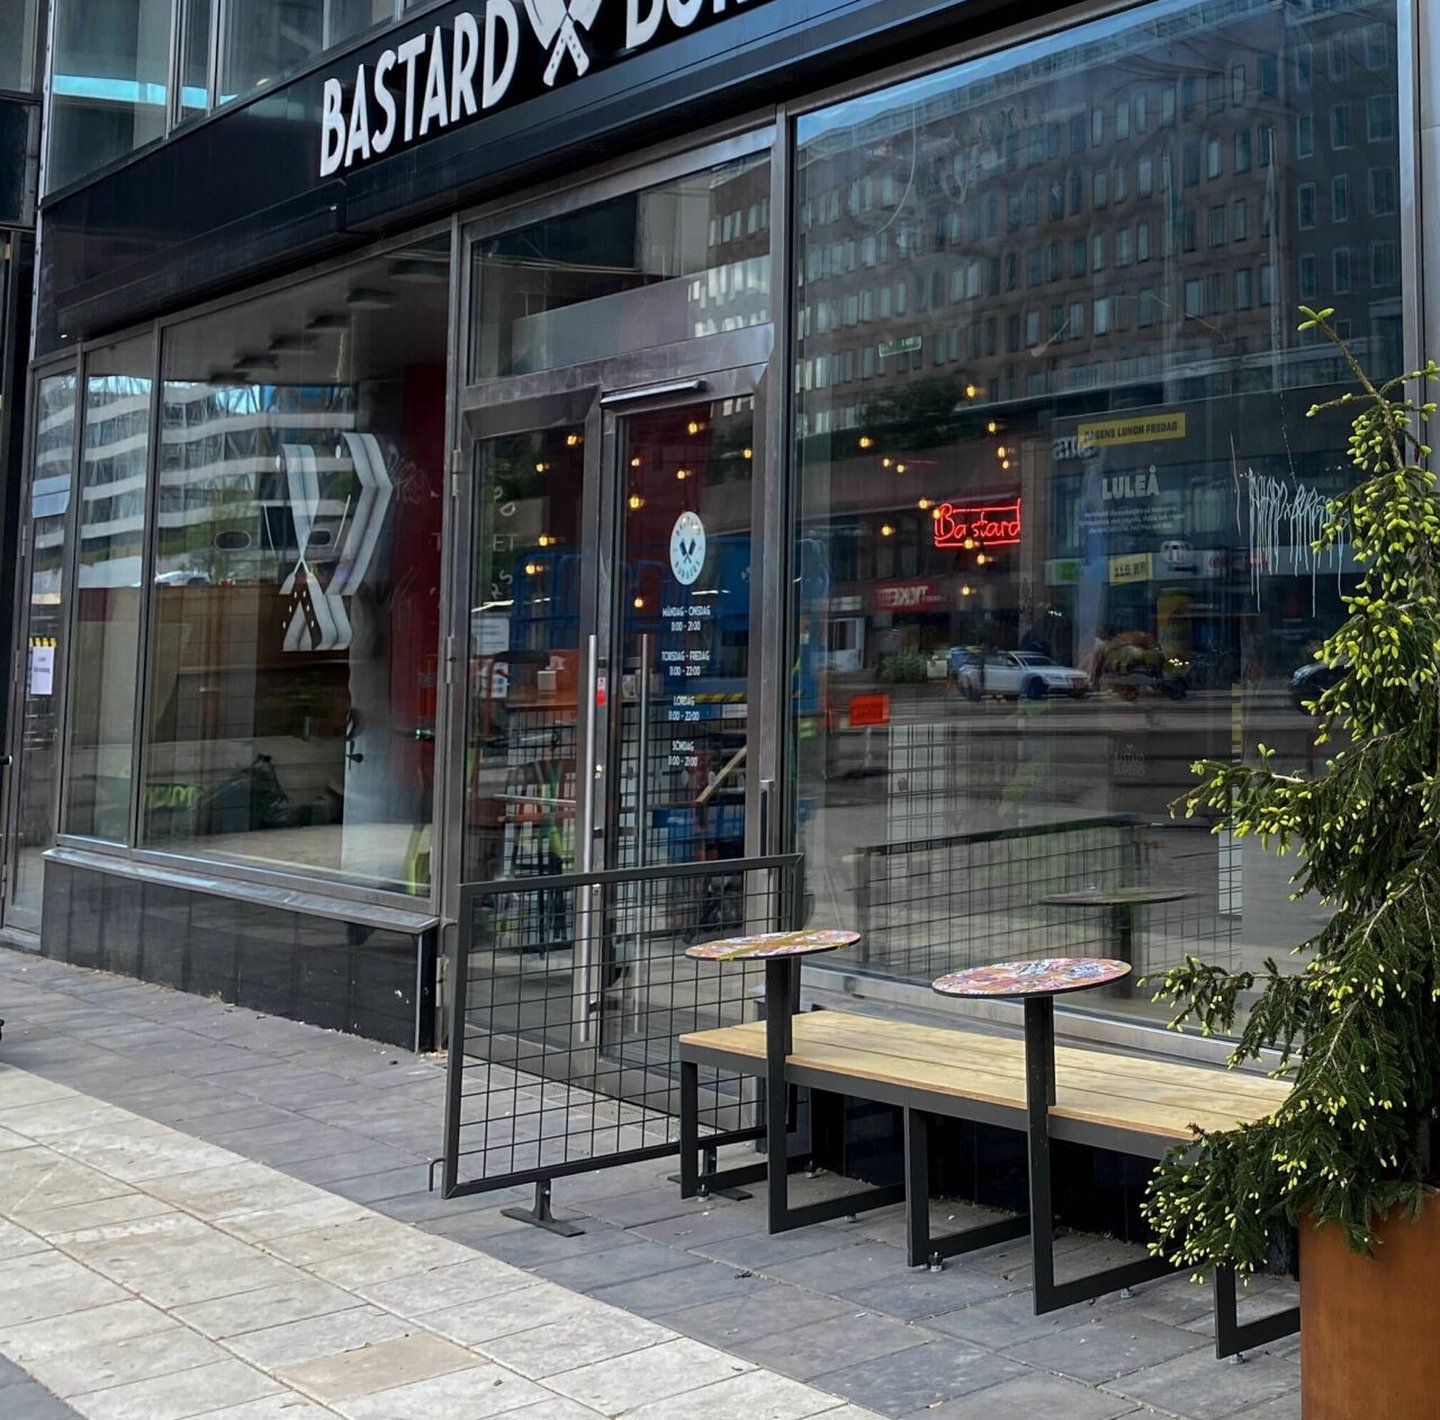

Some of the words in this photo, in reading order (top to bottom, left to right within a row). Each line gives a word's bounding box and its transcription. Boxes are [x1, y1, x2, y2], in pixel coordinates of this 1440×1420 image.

[320, 0, 520, 178] BASTARD
[1102, 464, 1160, 500] LULEÅ
[935, 499, 1020, 541] Bastard
